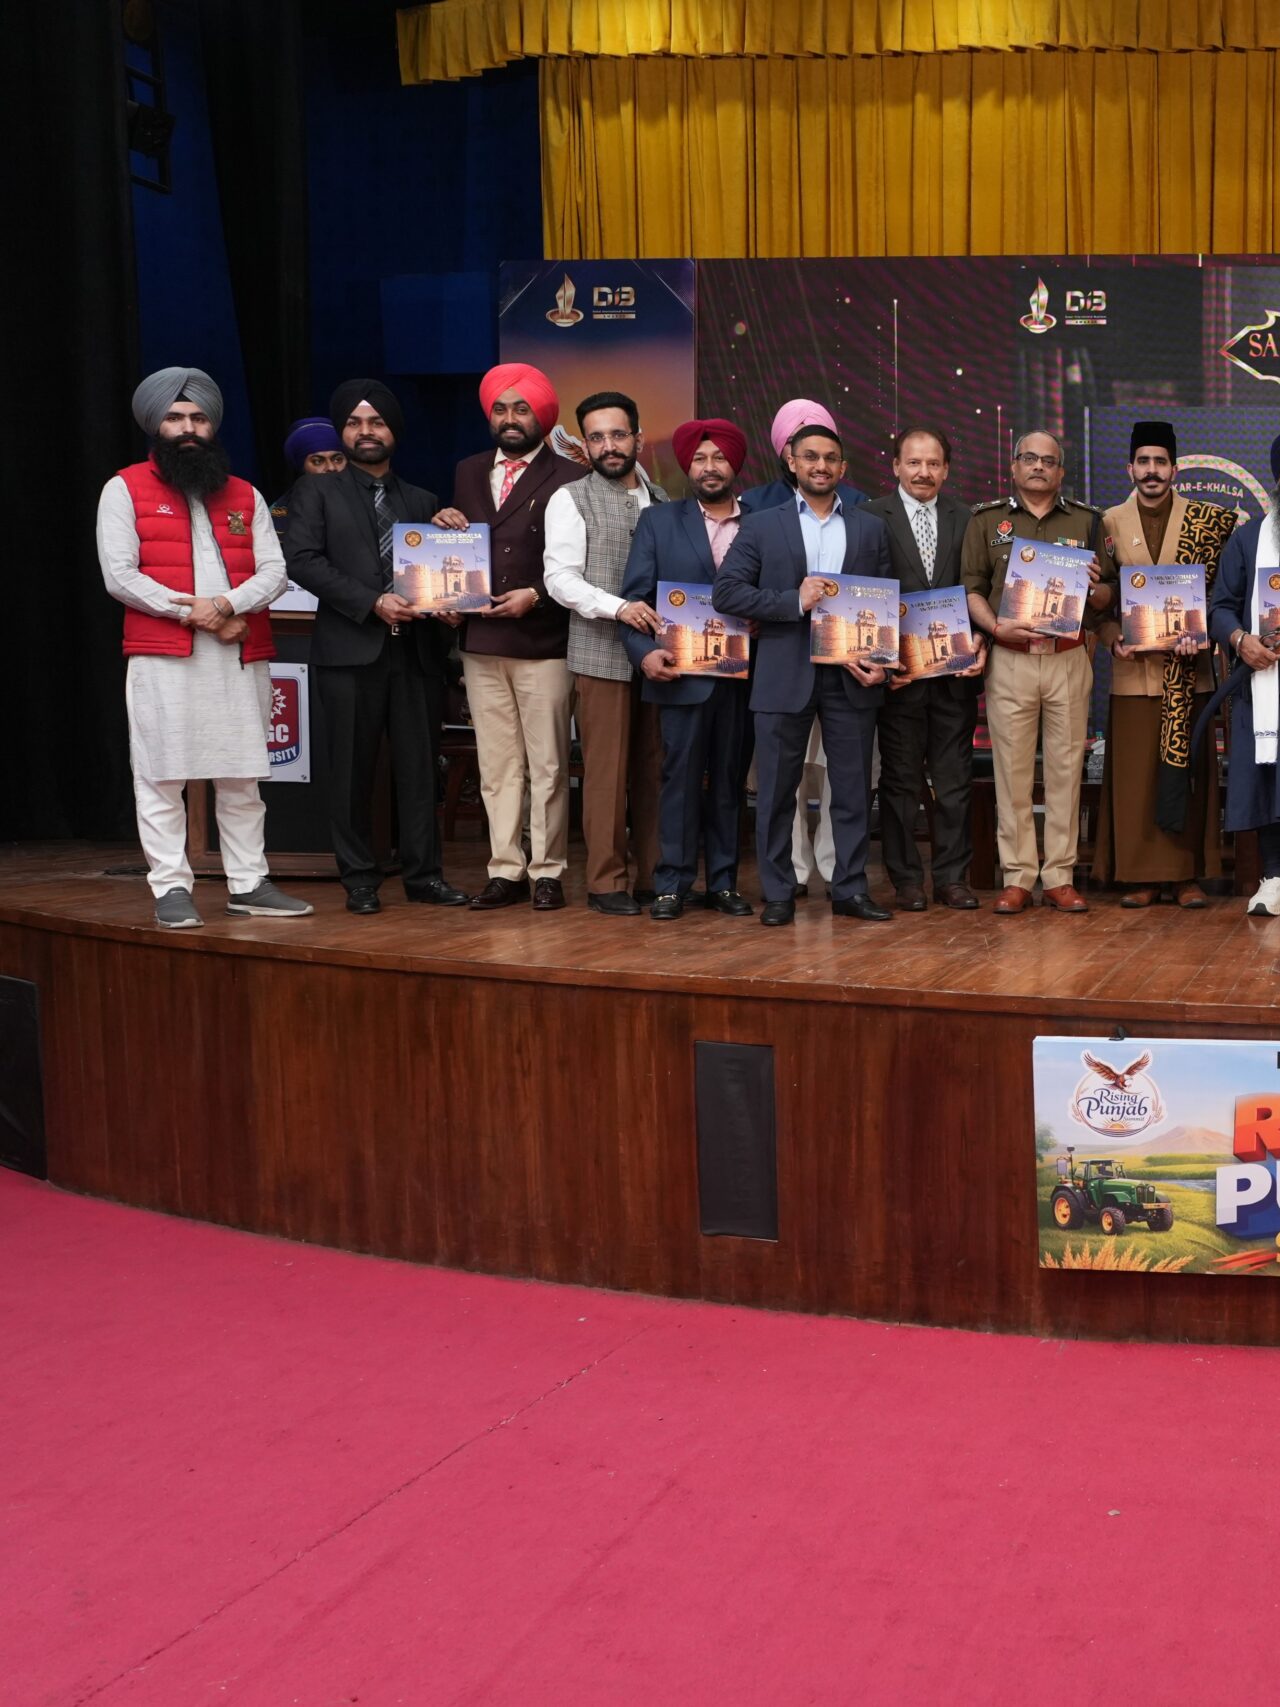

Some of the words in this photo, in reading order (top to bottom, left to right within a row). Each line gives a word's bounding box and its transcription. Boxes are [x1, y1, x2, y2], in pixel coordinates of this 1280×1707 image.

[1171, 481, 1244, 499] KAR-E-KHALSA
[266, 723, 289, 743] GC
[268, 745, 297, 763] RSITY
[1093, 1088, 1138, 1105] Rising
[1077, 1096, 1150, 1122] Punjab
